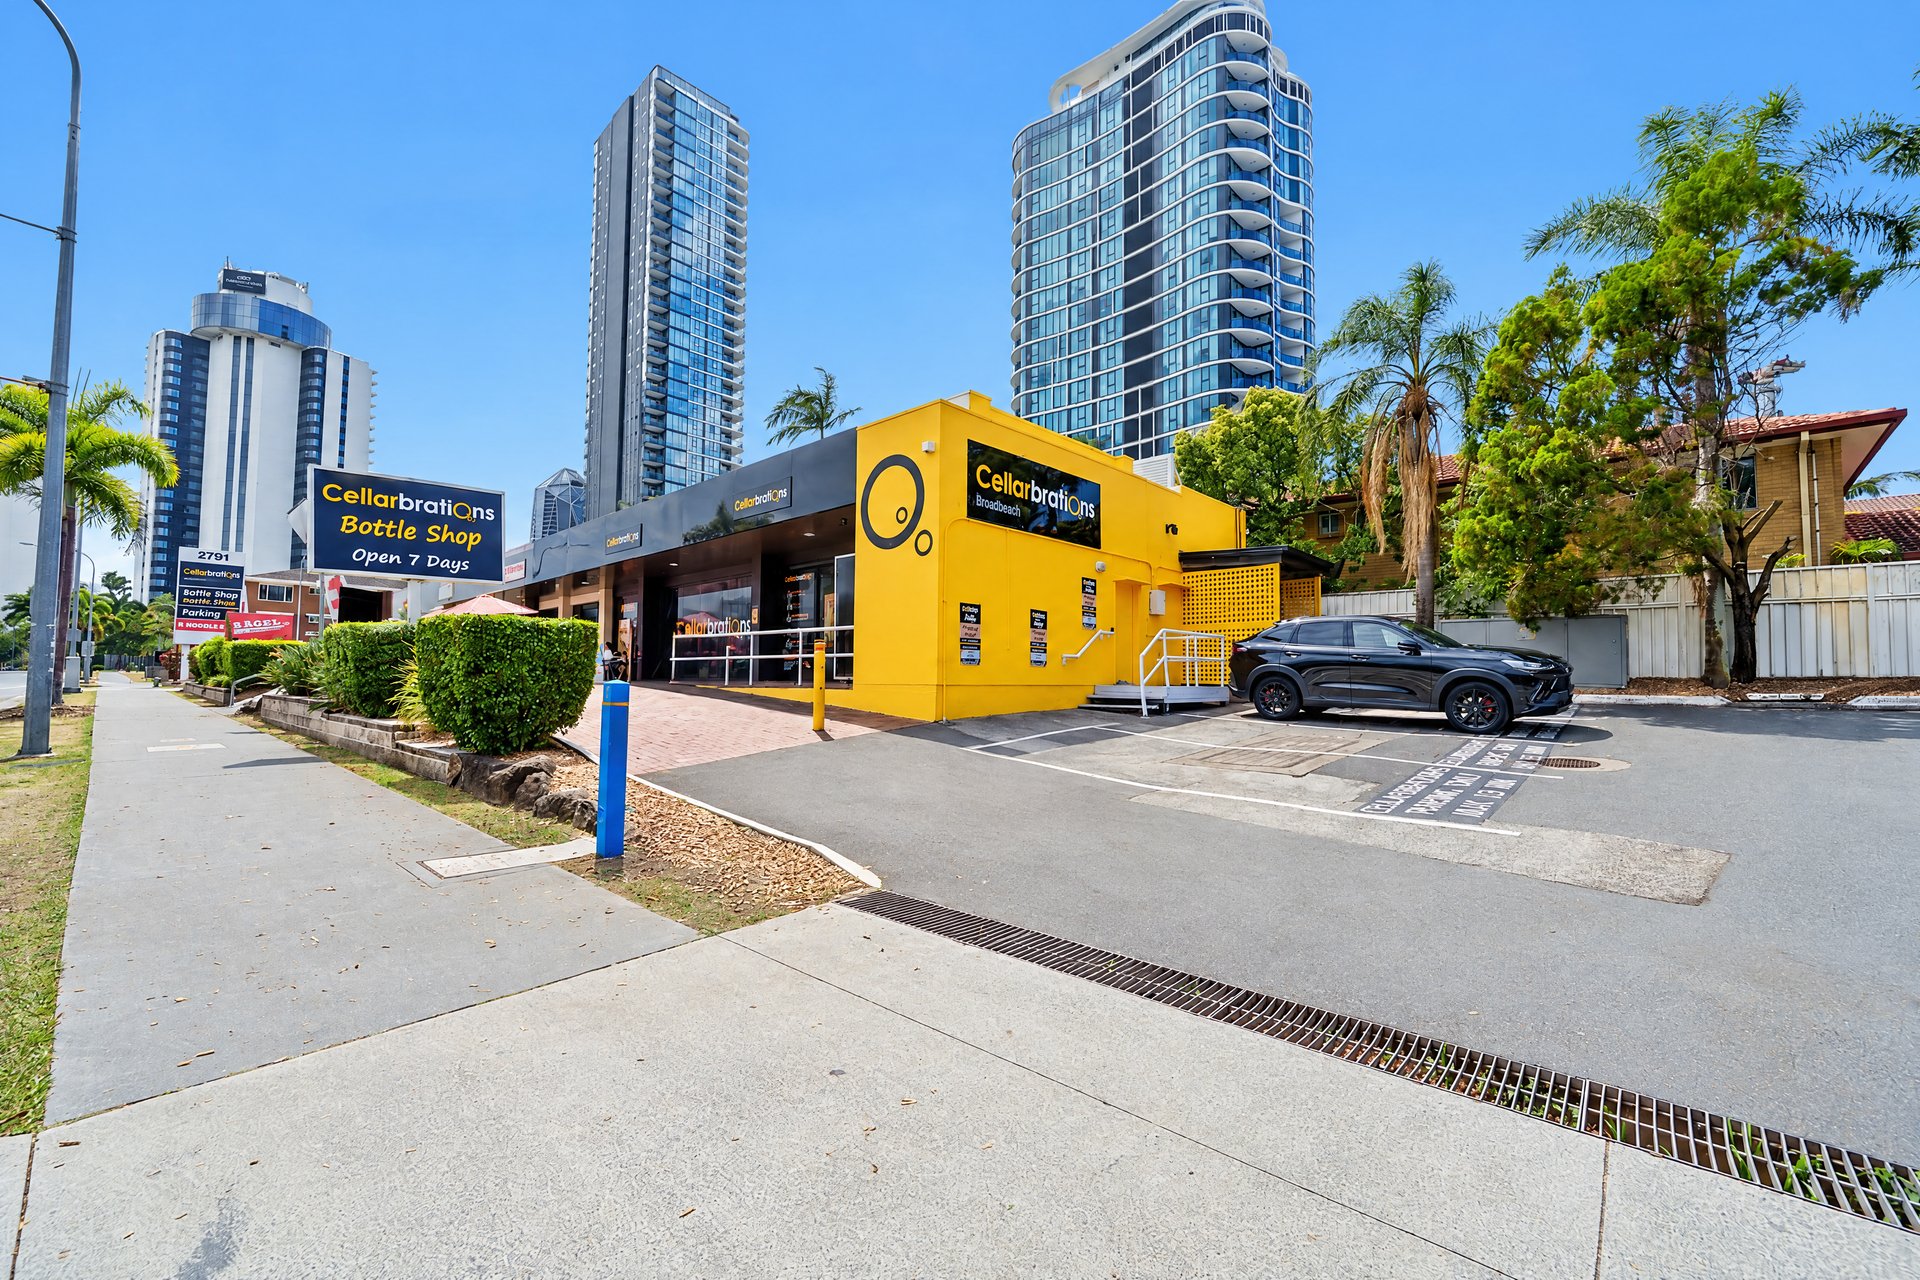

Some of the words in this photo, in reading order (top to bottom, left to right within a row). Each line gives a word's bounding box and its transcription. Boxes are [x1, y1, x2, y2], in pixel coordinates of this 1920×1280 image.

[322, 483, 495, 522] Cellarbrations
[735, 488, 787, 511] Cellarbrations
[976, 464, 1095, 519] Cellarbrations
[975, 494, 1021, 517] Broadbeach
[340, 515, 417, 541] Bottle
[426, 524, 482, 552] Shop
[198, 551, 229, 561] 2791
[352, 548, 402, 567] Open
[408, 553, 420, 566] 7
[426, 555, 470, 574] Days
[183, 568, 240, 579] Cellarbrations
[183, 589, 212, 598] Bottle
[214, 590, 238, 601] Shop
[182, 608, 221, 620] Parking
[186, 622, 218, 630] NOODLE
